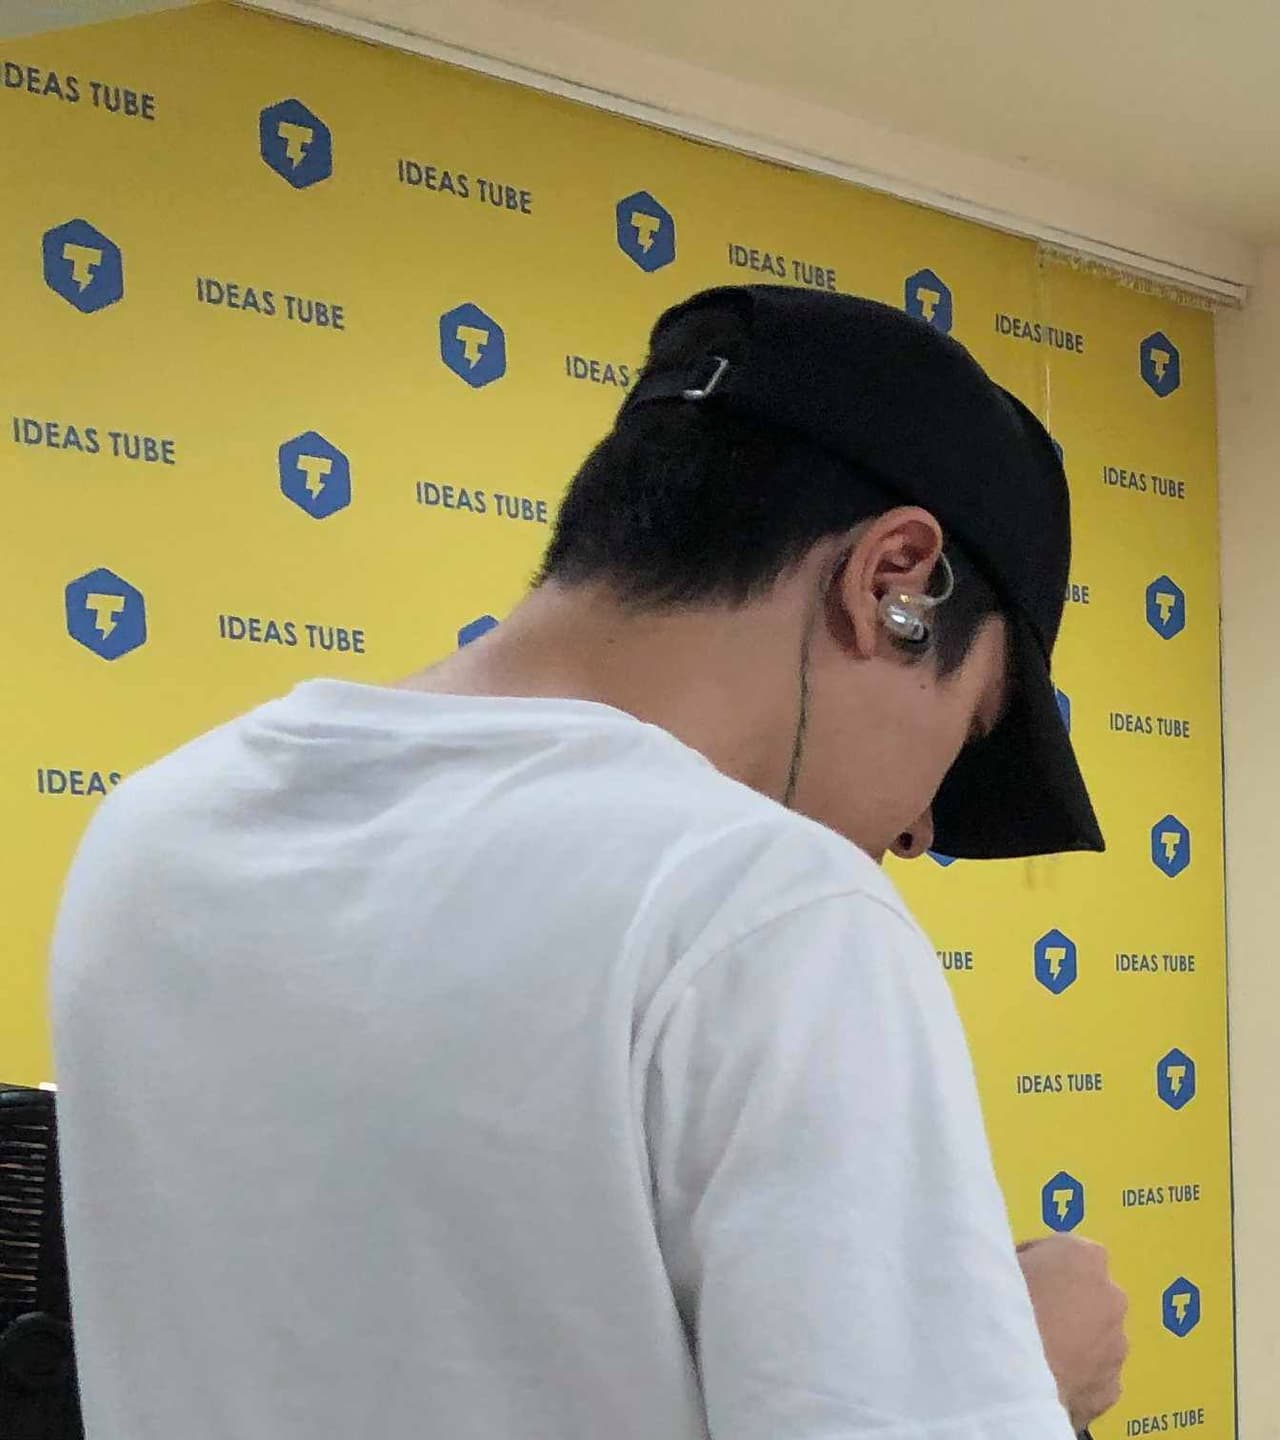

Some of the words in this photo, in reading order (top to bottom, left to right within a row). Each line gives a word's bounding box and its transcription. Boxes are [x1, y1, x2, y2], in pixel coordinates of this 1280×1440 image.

[4, 61, 80, 103] DEAS
[89, 81, 155, 121] TUBE
[398, 159, 470, 199] IDEAS
[476, 178, 532, 215] TUBE
[728, 243, 786, 278] IDEAS
[791, 260, 836, 292] TUBE
[196, 277, 276, 316] IDEAS
[283, 295, 345, 331] TUBE
[995, 313, 1042, 344] IDEAS
[1047, 327, 1084, 354] TUBE
[565, 354, 630, 388] IDEAS
[13, 416, 100, 454] IDEAS
[107, 431, 176, 465] TUBE
[415, 480, 487, 514] IDEAS
[493, 493, 548, 524] TUBE
[1103, 465, 1147, 492] IDEAS
[1151, 475, 1185, 500] TUBE
[218, 614, 298, 647] IDEAS
[304, 624, 366, 654] TUBE
[1109, 712, 1153, 735] IDEAS
[1156, 717, 1190, 739] TUBE
[1115, 953, 1159, 973] IDEAS
[1161, 954, 1196, 973] TUBE
[1016, 1074, 1063, 1094] IDEAS
[1066, 1073, 1103, 1092] TUBE
[1122, 1186, 1164, 1208] IDEAS
[1167, 1184, 1200, 1204] TUBE
[1126, 1413, 1167, 1437] IDEAS
[1171, 1407, 1205, 1430] TUBE
